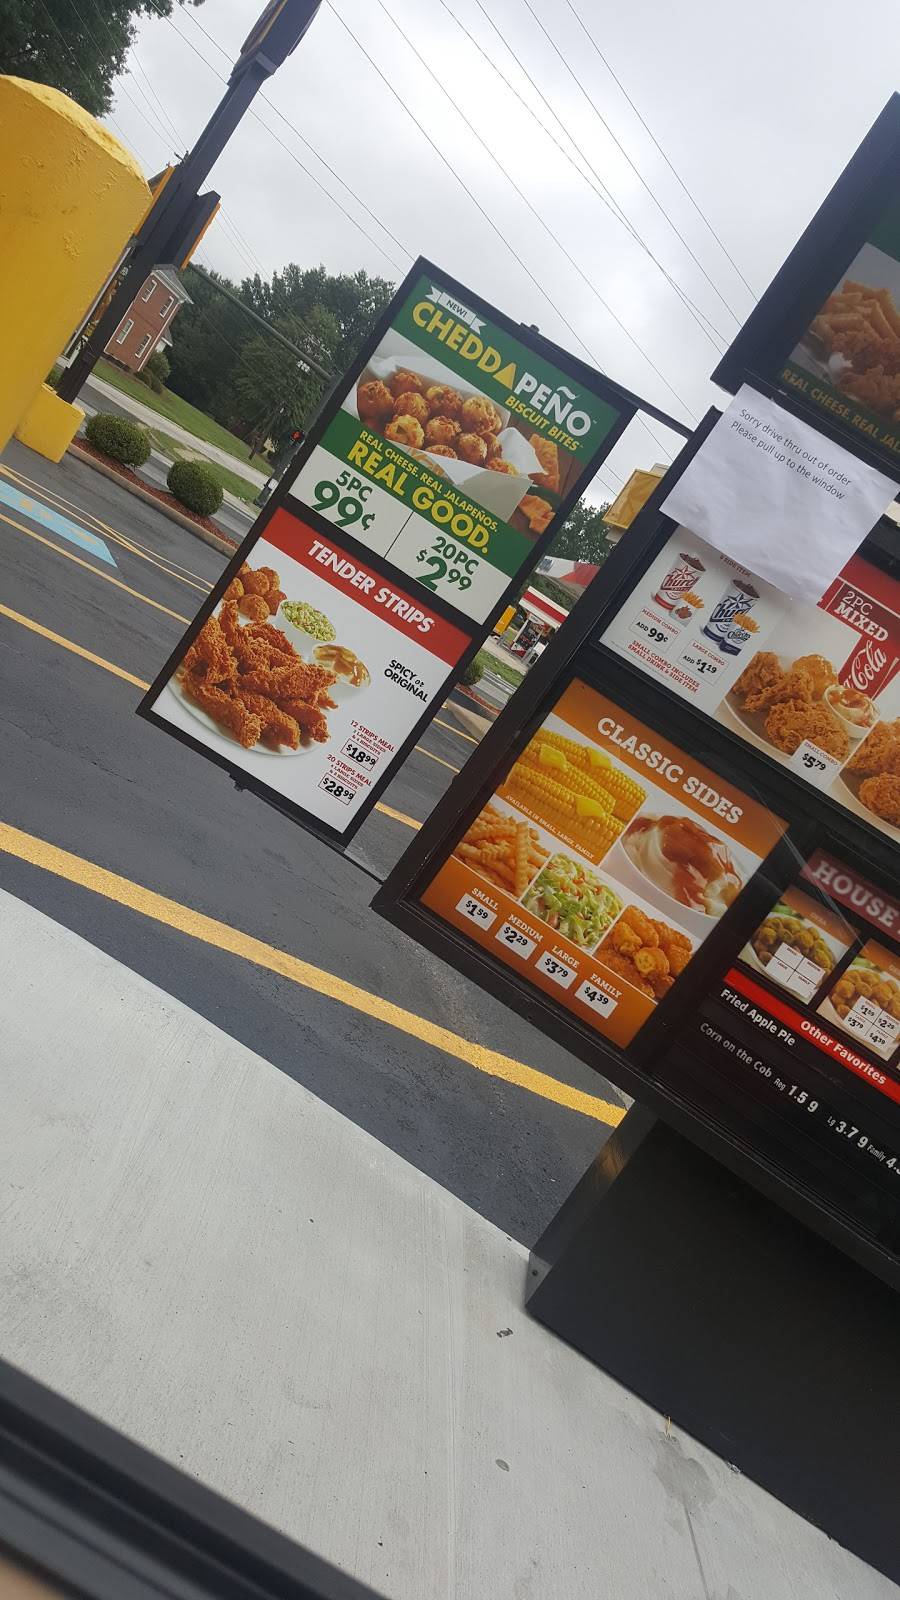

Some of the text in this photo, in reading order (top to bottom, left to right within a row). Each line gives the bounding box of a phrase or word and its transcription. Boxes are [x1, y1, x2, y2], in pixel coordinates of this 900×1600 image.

[446, 300, 468, 318] NEW!
[505, 396, 580, 451] BISCUIT BITES
[782, 369, 808, 392] REAL
[852, 414, 880, 438] REAL
[731, 420, 846, 500] Please pull up to the window
[740, 409, 852, 486] Sorry drive thru out of order
[336, 470, 373, 502] 5PC
[347, 441, 490, 554] REAL GOOD.
[359, 432, 498, 532] REAL CHEESE. REAL JALAPEÑOS.
[310, 480, 376, 530] 99¢
[431, 536, 480, 576] 20PC
[308, 540, 434, 632] TENDER STRIPS
[842, 590, 872, 616] 2PC
[636, 621, 668, 644] ADD 99¢
[662, 620, 679, 635] COMBO
[834, 602, 888, 642] MIXED
[389, 660, 416, 680] SPICY
[628, 644, 646, 659] SMALL
[646, 656, 666, 672] DRINK
[670, 672, 683, 684] SIDE
[682, 680, 698, 694] ITEM
[632, 640, 650, 654] SMALL
[650, 652, 672, 668] COMBO
[672, 666, 700, 688] INCLUDES
[682, 654, 695, 664] ADD
[692, 642, 726, 666] LARGE COMBO
[384, 668, 428, 702] ORIGINAL
[350, 720, 394, 752] 12 STRIPS MEAL
[328, 754, 336, 762] 20
[336, 760, 356, 775] STRIPS
[356, 773, 372, 786] MEAL
[597, 718, 744, 824] CLASSIC SIDES
[505, 795, 533, 816] AVAILABLE
[532, 812, 540, 820] IN
[574, 844, 595, 860] FAMILY
[471, 887, 499, 911] SMALL
[812, 860, 900, 928] HOUSE
[508, 914, 544, 942] MEDIUM
[552, 946, 580, 968] LARGE
[590, 973, 623, 998] FAMILY
[720, 988, 796, 1046] Fried Apple Pie
[800, 1020, 886, 1084] Other Favorites
[700, 1022, 723, 1043] Corn
[722, 1038, 736, 1052] on
[736, 1048, 754, 1064] the
[753, 1060, 773, 1078] Cob
[774, 1077, 786, 1090] Reg
[827, 1116, 836, 1126] Lg
[866, 1144, 886, 1162] Family
